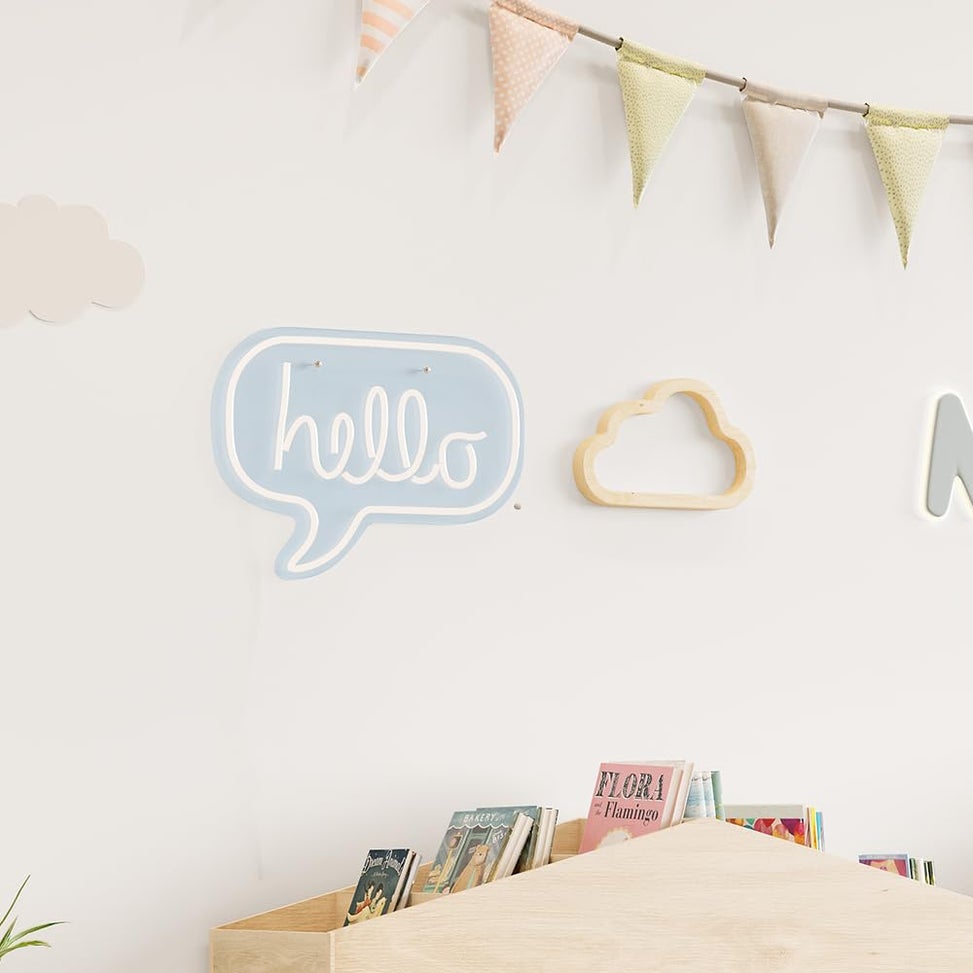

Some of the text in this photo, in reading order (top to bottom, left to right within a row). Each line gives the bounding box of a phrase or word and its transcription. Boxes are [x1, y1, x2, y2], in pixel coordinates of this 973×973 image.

[274, 361, 488, 490] hello
[594, 771, 665, 801] FLORA
[604, 801, 659, 827] Flamingo
